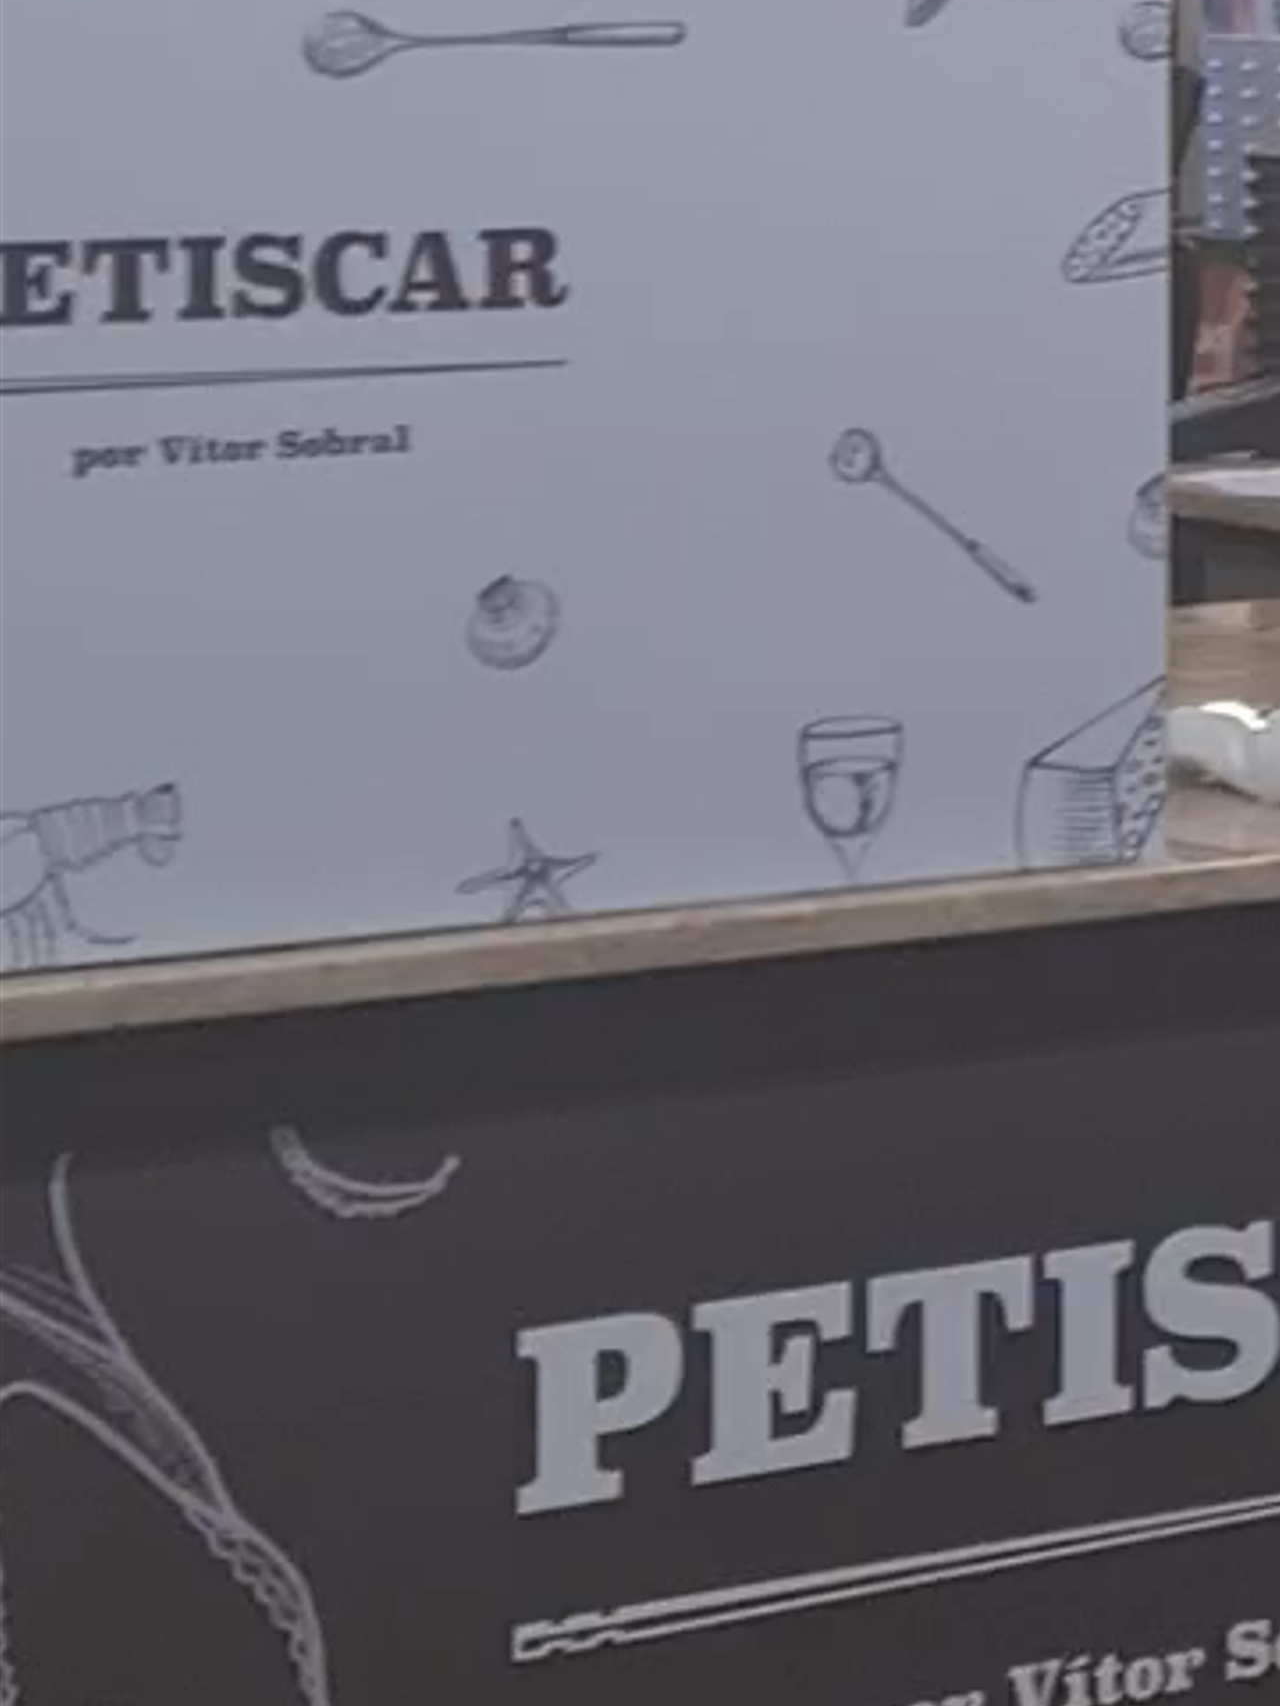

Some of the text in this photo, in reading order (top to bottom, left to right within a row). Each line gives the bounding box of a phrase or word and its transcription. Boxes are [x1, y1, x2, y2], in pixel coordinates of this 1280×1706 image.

[0, 227, 570, 327] ETISCAR
[71, 442, 150, 478] por
[275, 425, 414, 462] Sobral
